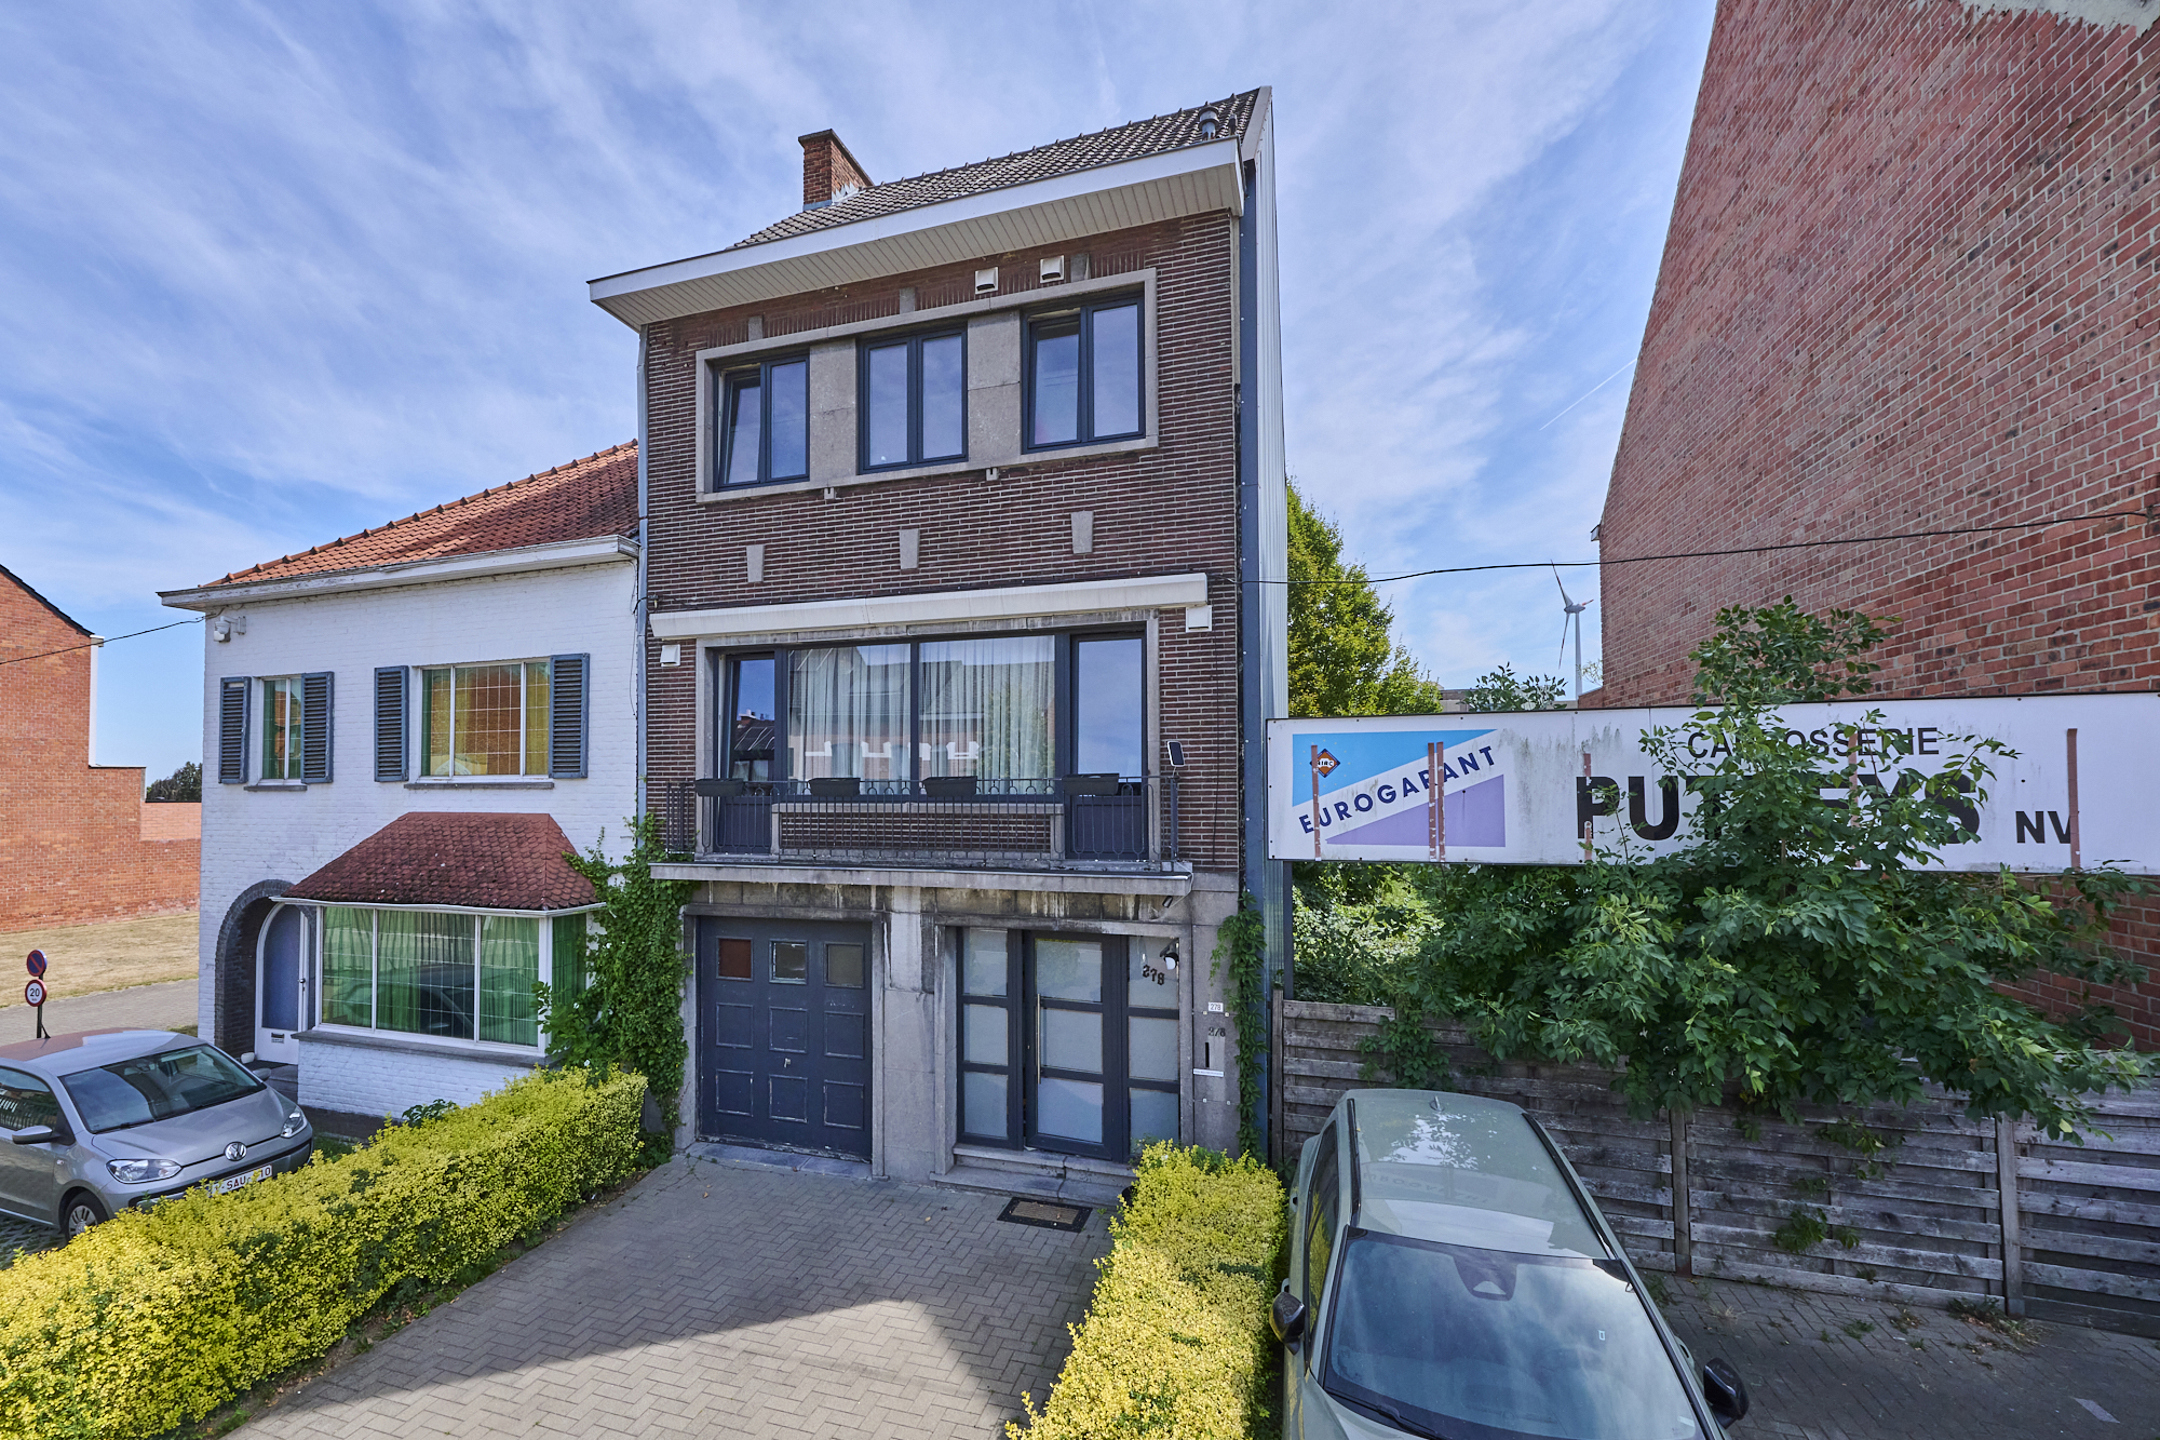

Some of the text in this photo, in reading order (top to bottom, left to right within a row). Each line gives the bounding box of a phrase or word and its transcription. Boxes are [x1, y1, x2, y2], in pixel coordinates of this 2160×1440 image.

[1687, 727, 1939, 759] CAOSSERIE
[2015, 810, 2080, 844] NV
[1142, 964, 1165, 986] 278
[29, 987, 41, 997] 20
[1210, 1003, 1222, 1011] 278
[1208, 1027, 1226, 1037] 278
